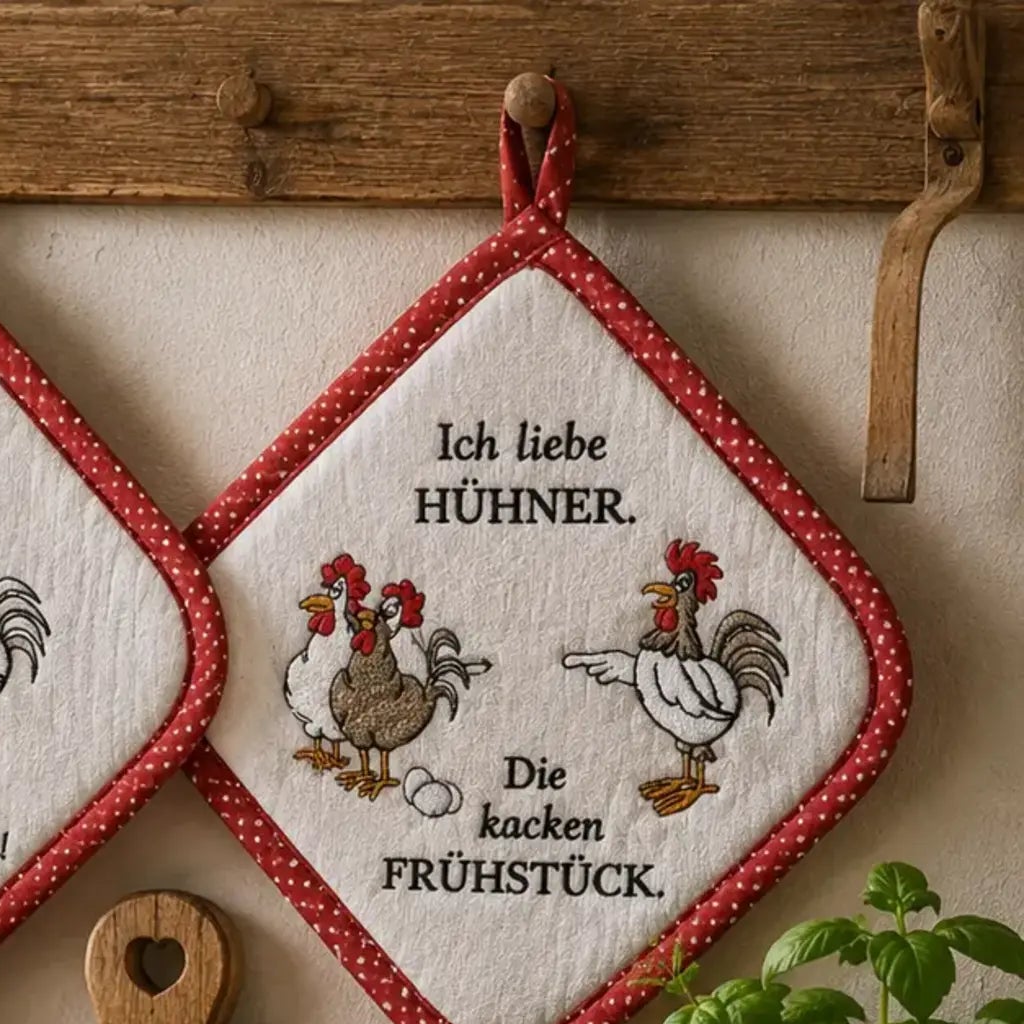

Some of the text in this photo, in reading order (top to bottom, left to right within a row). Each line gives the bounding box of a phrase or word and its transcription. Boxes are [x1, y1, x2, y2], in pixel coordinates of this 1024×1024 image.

[437, 419, 607, 462] Ich liebe
[414, 477, 637, 525] HÜHNER.
[503, 755, 567, 791] Die
[477, 801, 605, 842] kacken
[381, 850, 665, 900] FRÜHSTÜCK.
